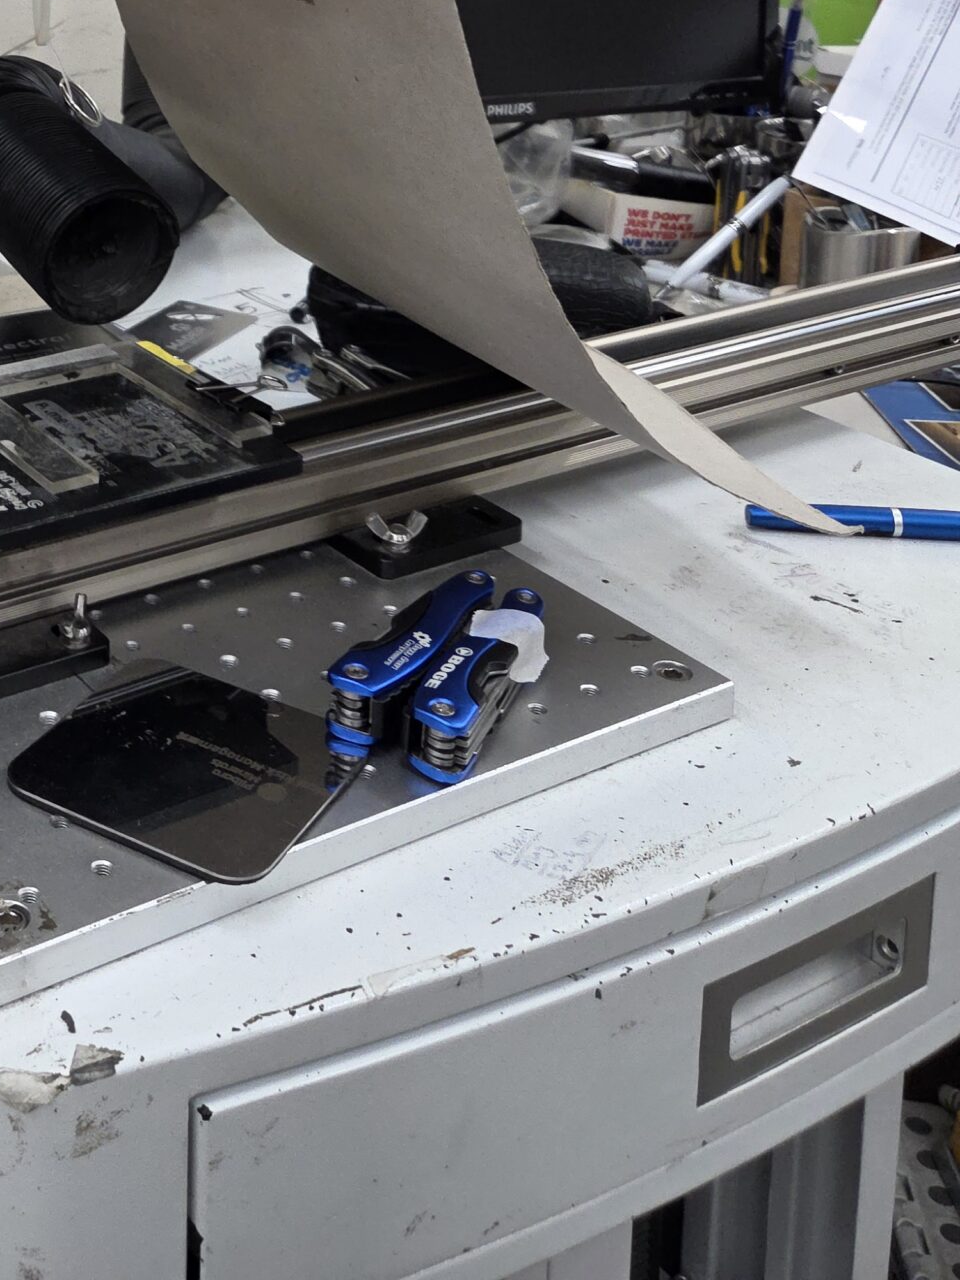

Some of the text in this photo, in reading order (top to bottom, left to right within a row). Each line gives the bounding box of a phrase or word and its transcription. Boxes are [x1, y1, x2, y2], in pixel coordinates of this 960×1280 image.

[487, 102, 534, 117] PHILIPS
[627, 208, 692, 221] WE DON'T
[623, 228, 677, 240] PRINTED
[624, 218, 694, 232] JUST MAKE
[424, 655, 465, 689] BOGE
[175, 731, 265, 772] Management
[209, 757, 262, 785] Minerals
[211, 768, 255, 791] Pilbara
